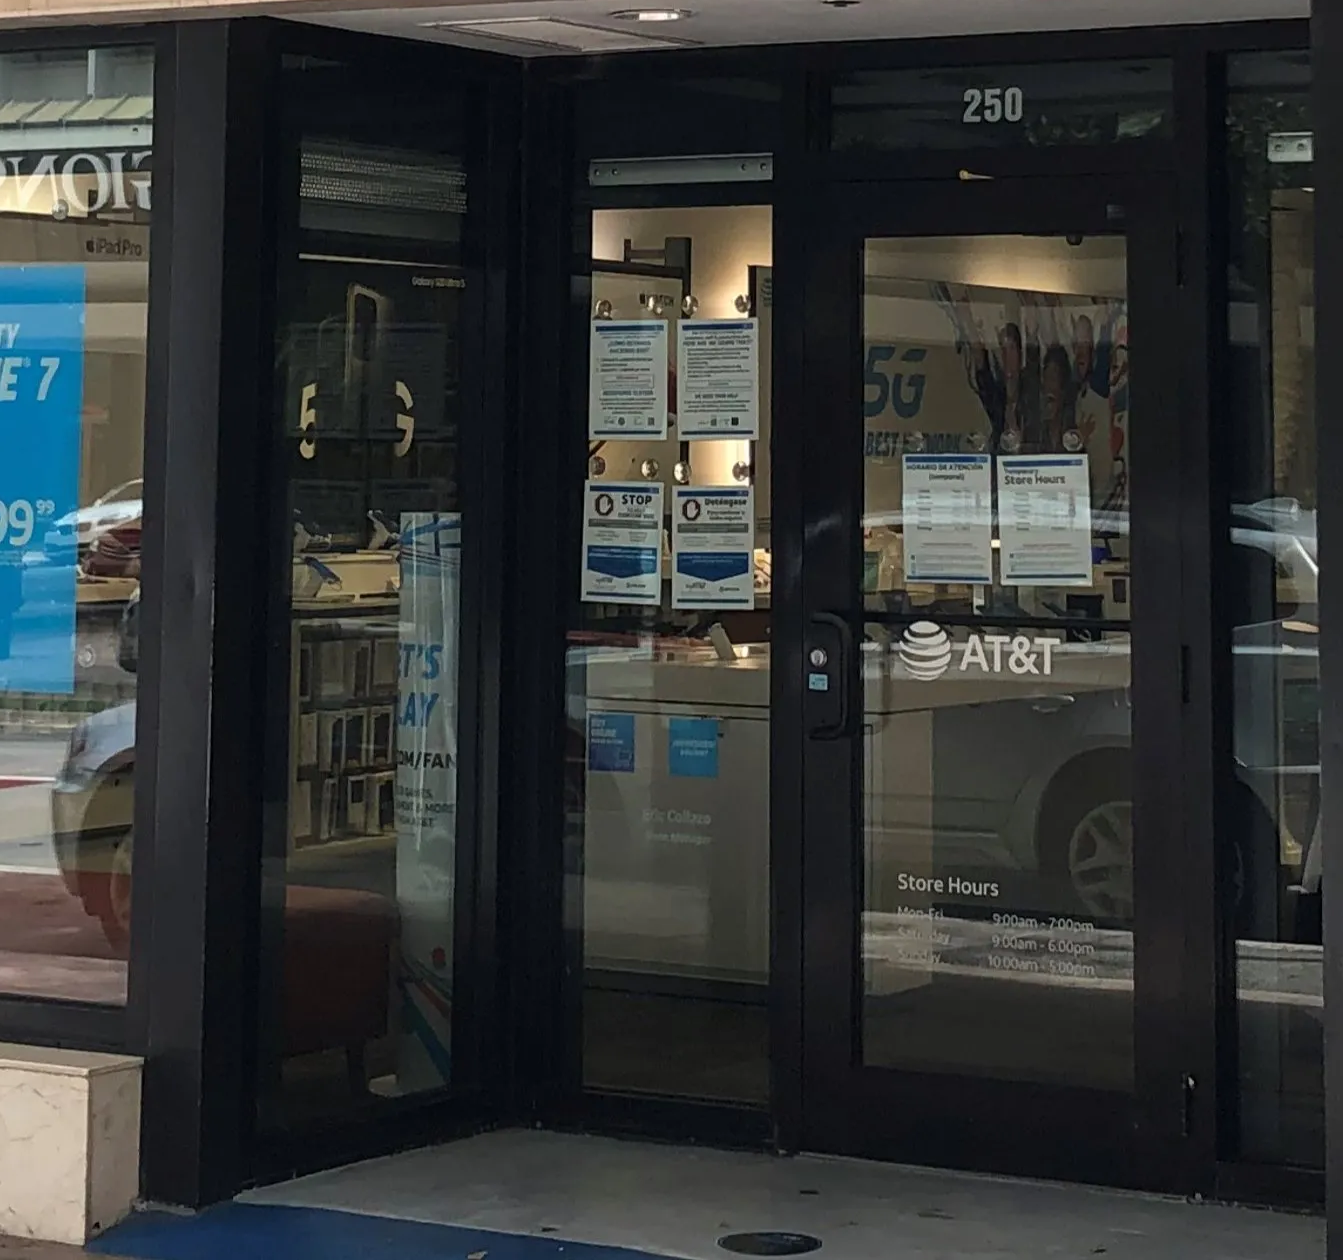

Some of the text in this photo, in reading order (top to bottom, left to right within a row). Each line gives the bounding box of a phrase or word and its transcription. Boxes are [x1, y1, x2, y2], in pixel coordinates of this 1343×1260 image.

[962, 86, 1024, 124] 250
[36, 357, 60, 402] 7
[864, 346, 928, 418] 5G
[1004, 475, 1066, 485] Store Hours
[622, 494, 652, 505] STOP
[959, 634, 1061, 675] AT&T
[897, 873, 999, 897] Store Hours
[992, 913, 1038, 929] 9:00am
[1048, 917, 1094, 934] 7:00pm
[897, 927, 950, 946] Satuday
[1048, 940, 1095, 956] 6:00pm
[898, 948, 941, 965] Sundy
